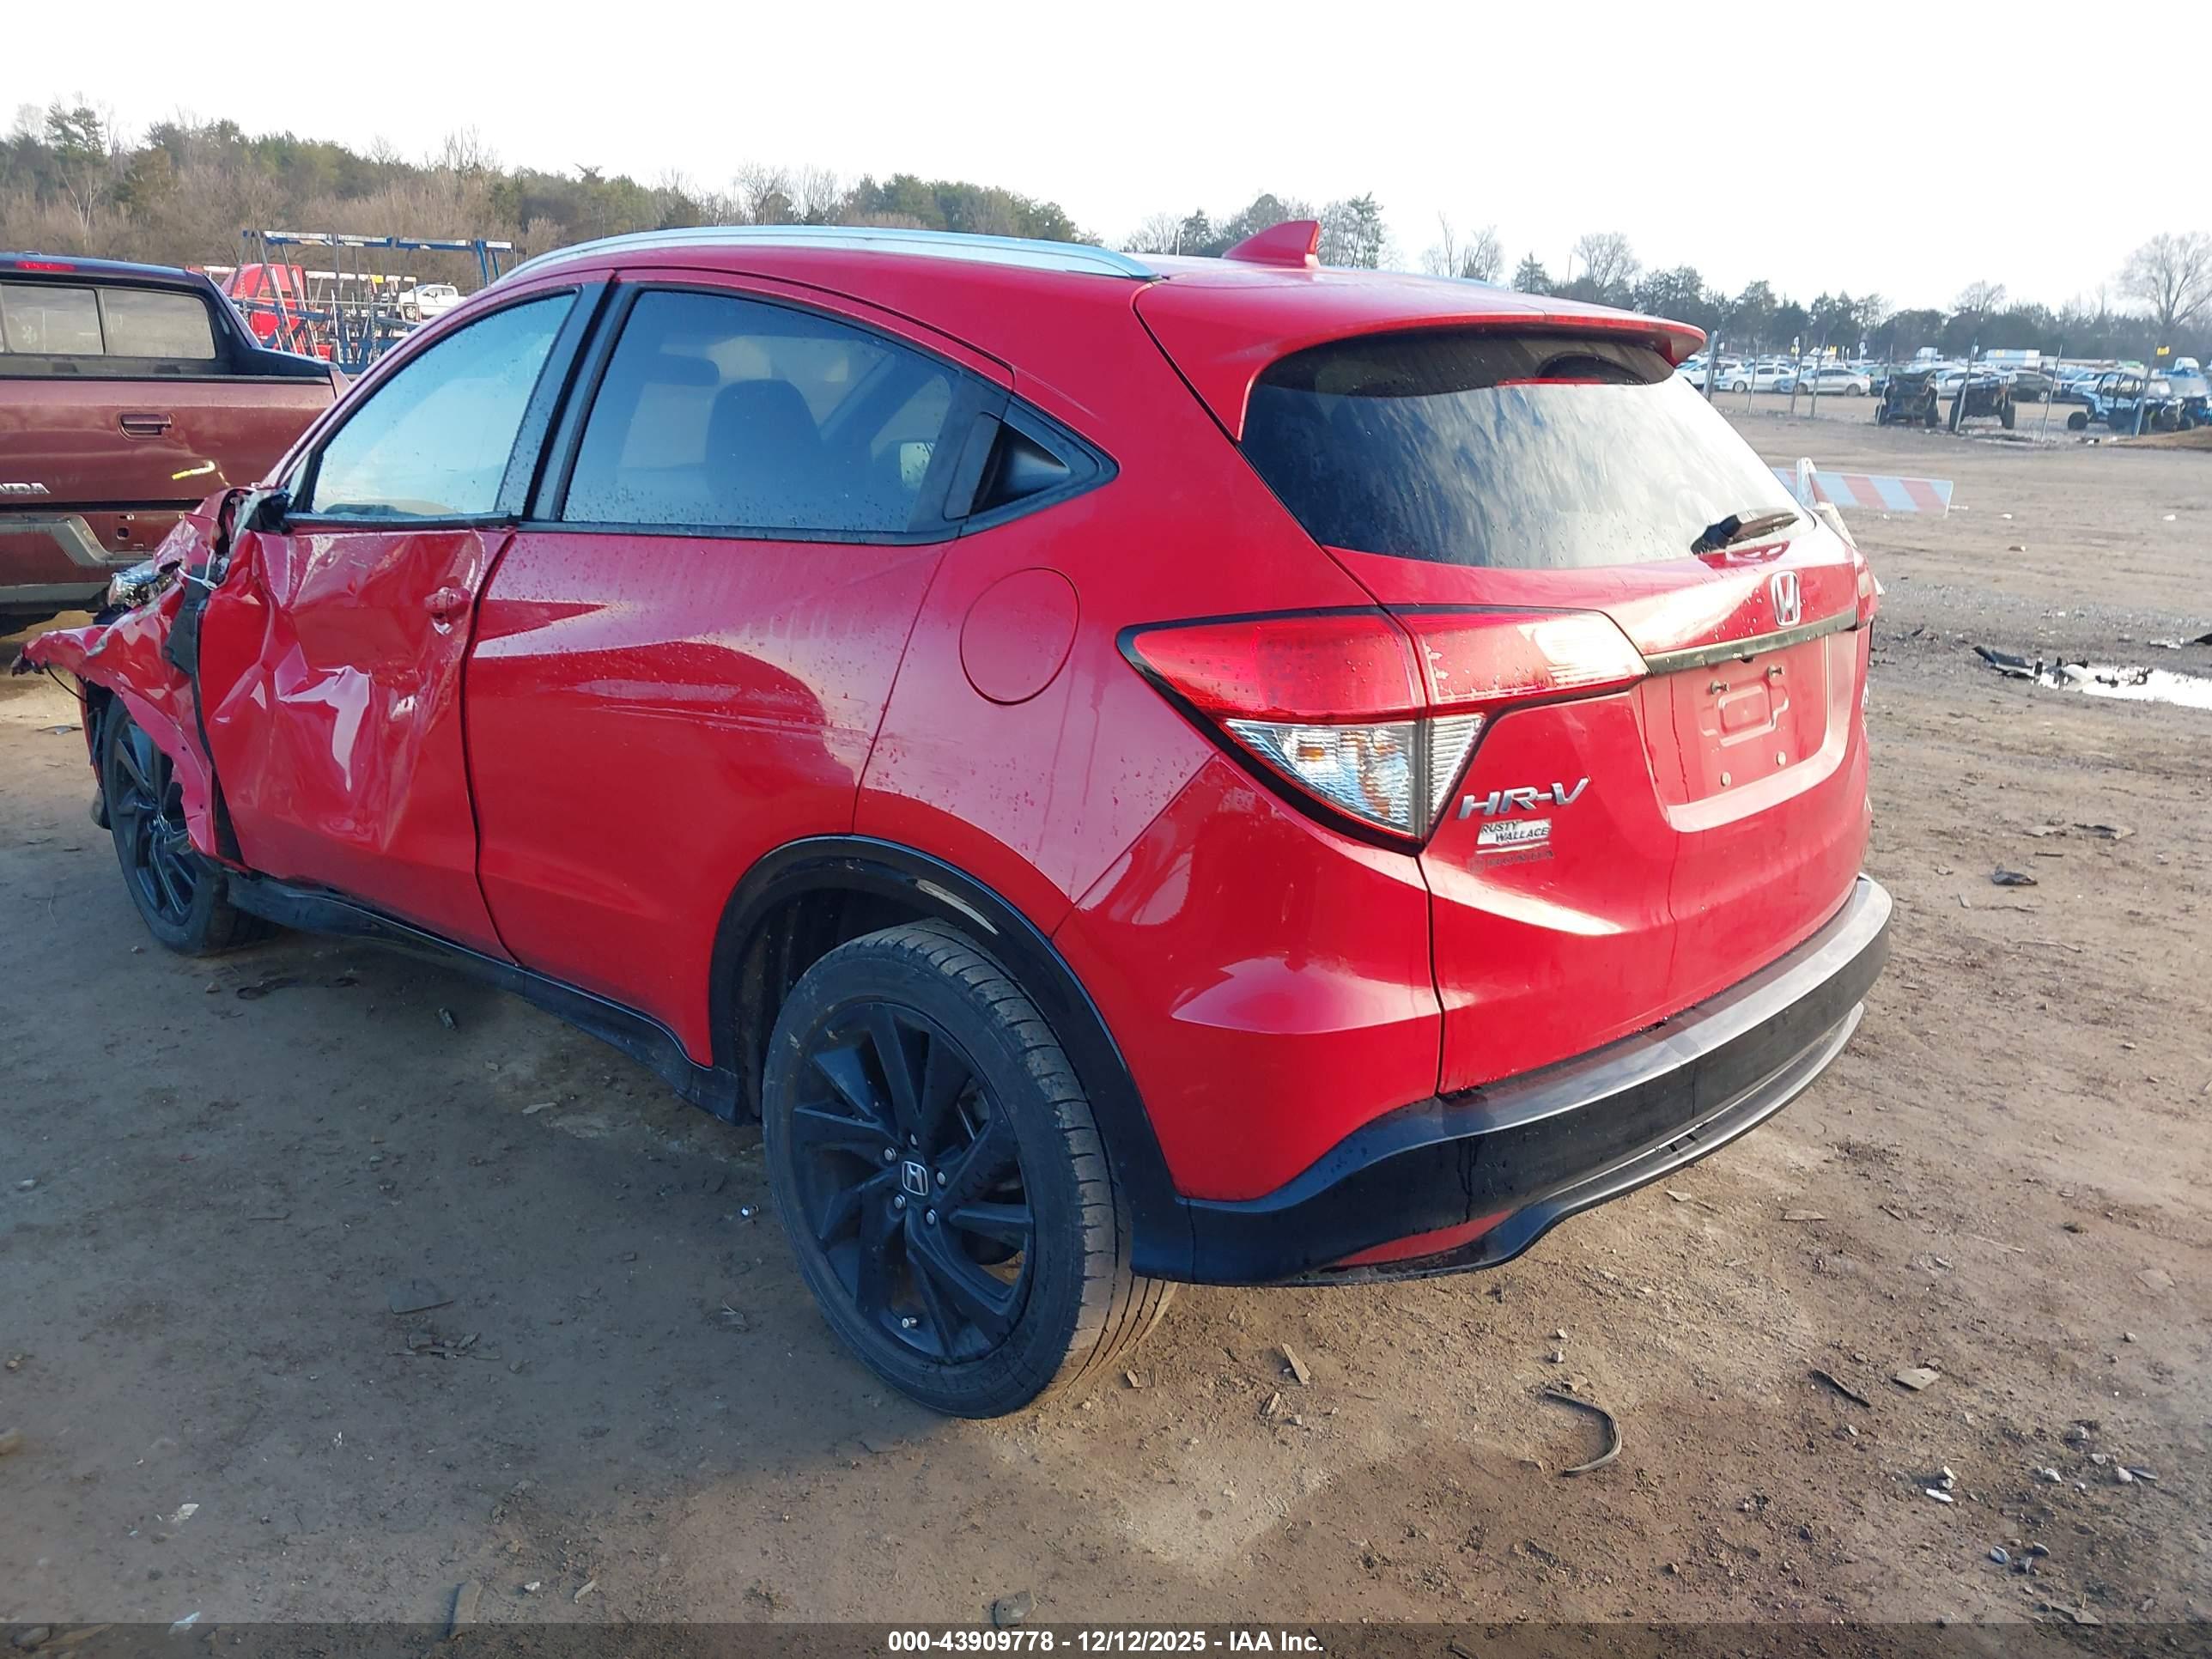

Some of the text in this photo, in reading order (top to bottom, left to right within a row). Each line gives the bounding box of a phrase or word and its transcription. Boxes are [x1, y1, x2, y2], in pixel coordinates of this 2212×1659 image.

[1457, 775, 1591, 819] HR-V
[1480, 820, 1519, 834] RUSTY
[1495, 827, 1550, 842] WALLACE
